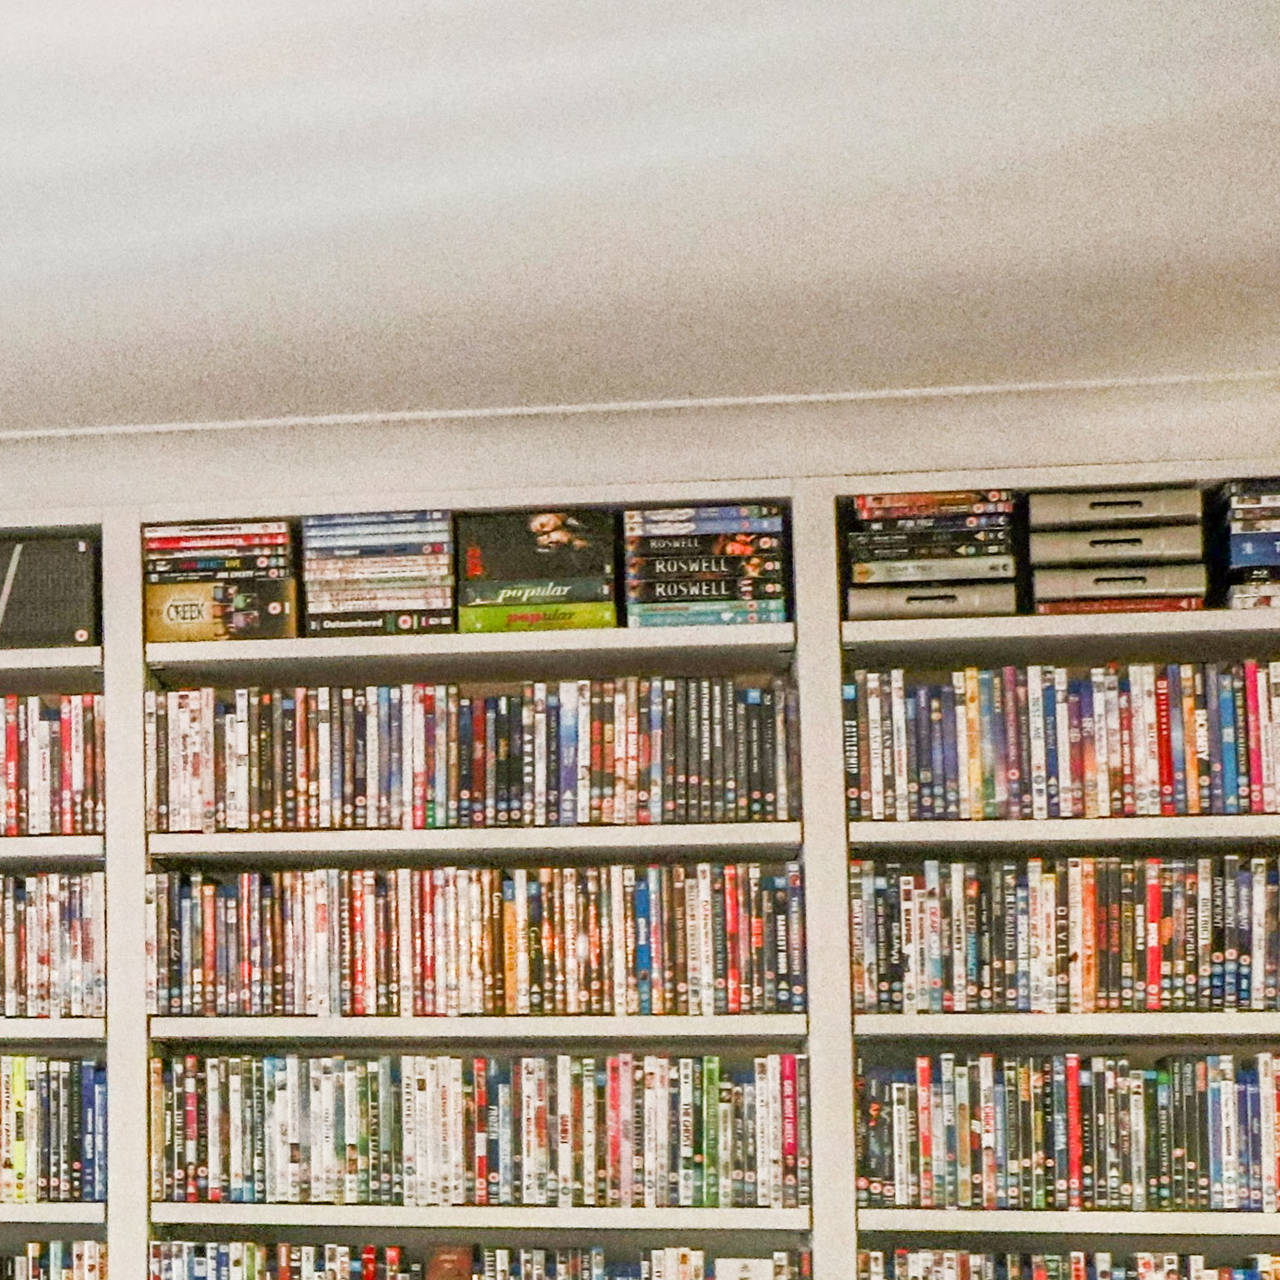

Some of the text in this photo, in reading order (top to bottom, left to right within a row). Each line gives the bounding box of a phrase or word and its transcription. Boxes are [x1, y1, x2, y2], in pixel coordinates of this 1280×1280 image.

[655, 559, 729, 573] ROSWELL
[655, 583, 729, 597] ROSWELL
[498, 585, 572, 603] popular
[702, 682, 710, 761] BATMAN FOREVER
[845, 720, 857, 775] BATTLESHIP
[1196, 709, 1210, 761] BOBBY
[1056, 906, 1066, 958] DEVIL
